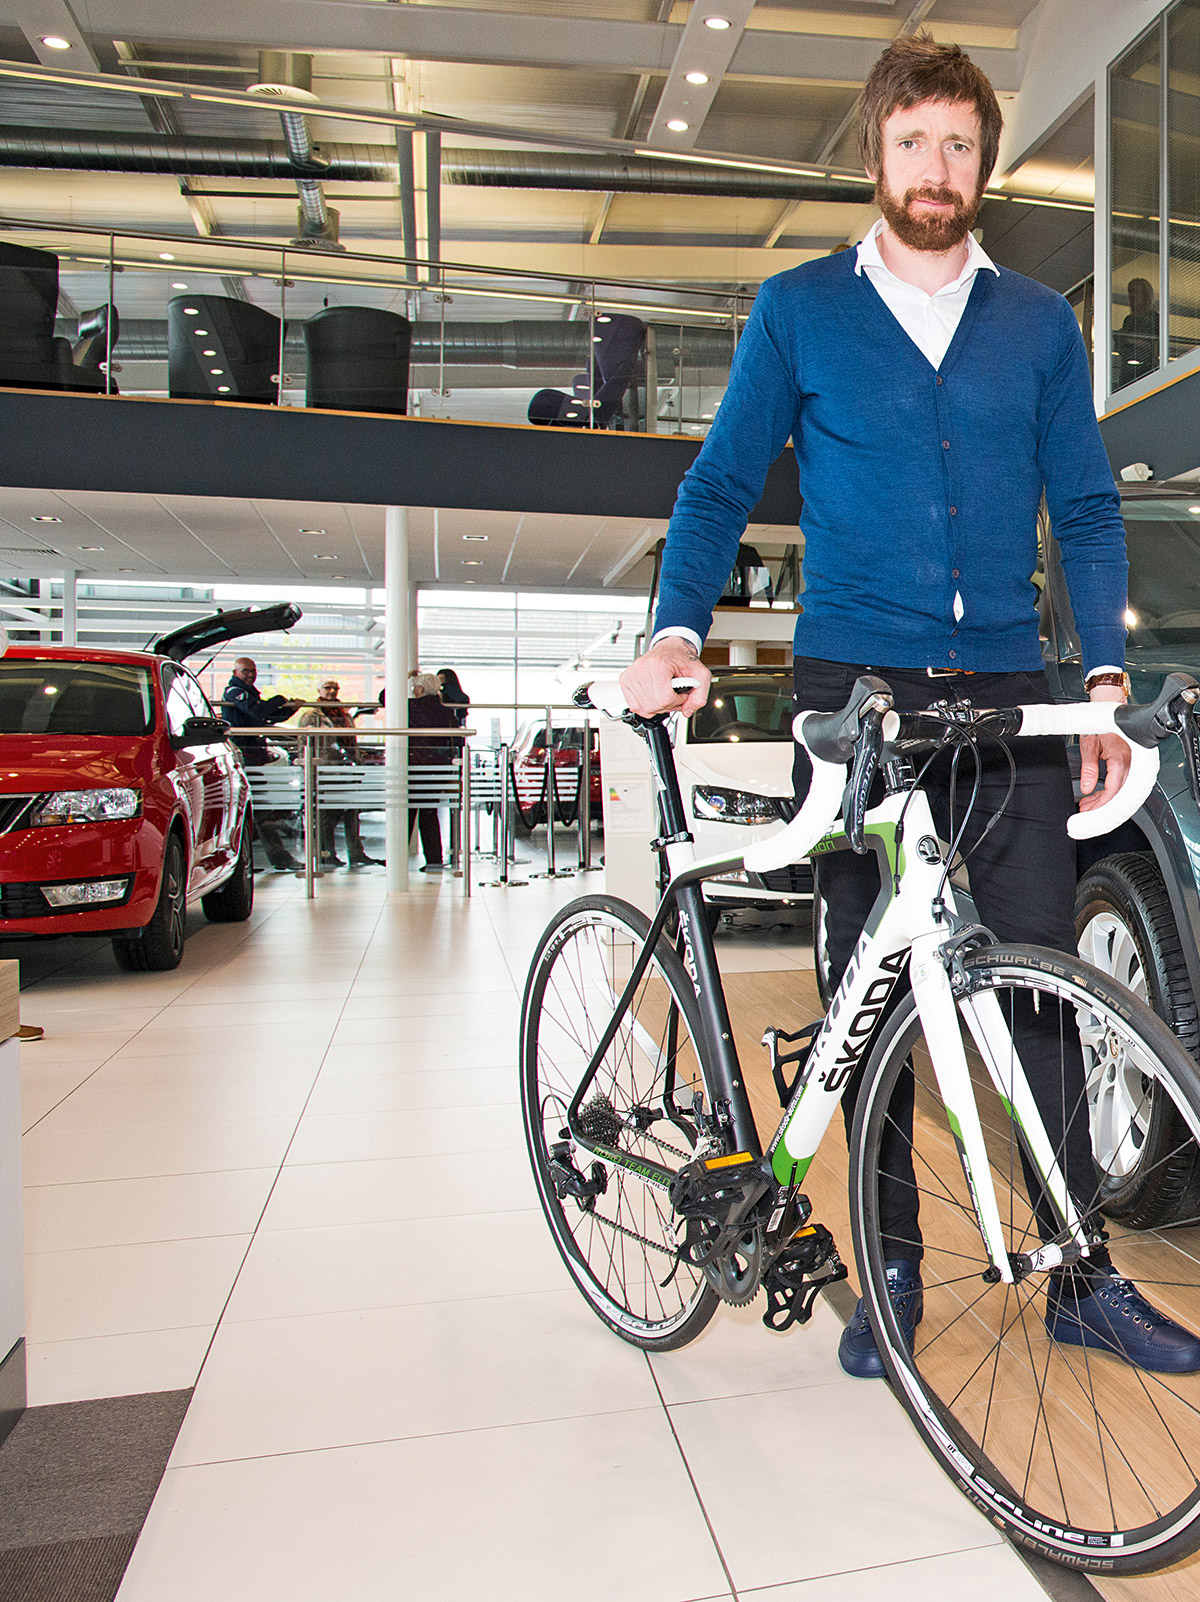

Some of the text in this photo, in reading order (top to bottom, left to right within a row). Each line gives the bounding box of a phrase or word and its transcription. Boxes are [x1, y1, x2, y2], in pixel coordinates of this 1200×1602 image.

[855, 751, 878, 825] ULTEGRA
[678, 909, 702, 999] ŠKODA
[963, 953, 1066, 977] SCHWALBE
[1092, 986, 1133, 1021] ONE
[818, 945, 913, 1093] ŠKODA
[592, 1145, 671, 1187] ROAD TEAM ELIT
[613, 1163, 668, 1193] SUPERIO
[947, 1443, 957, 1454] DT
[956, 1478, 990, 1513] ONE
[1011, 1529, 1115, 1569] SCHWALBE
